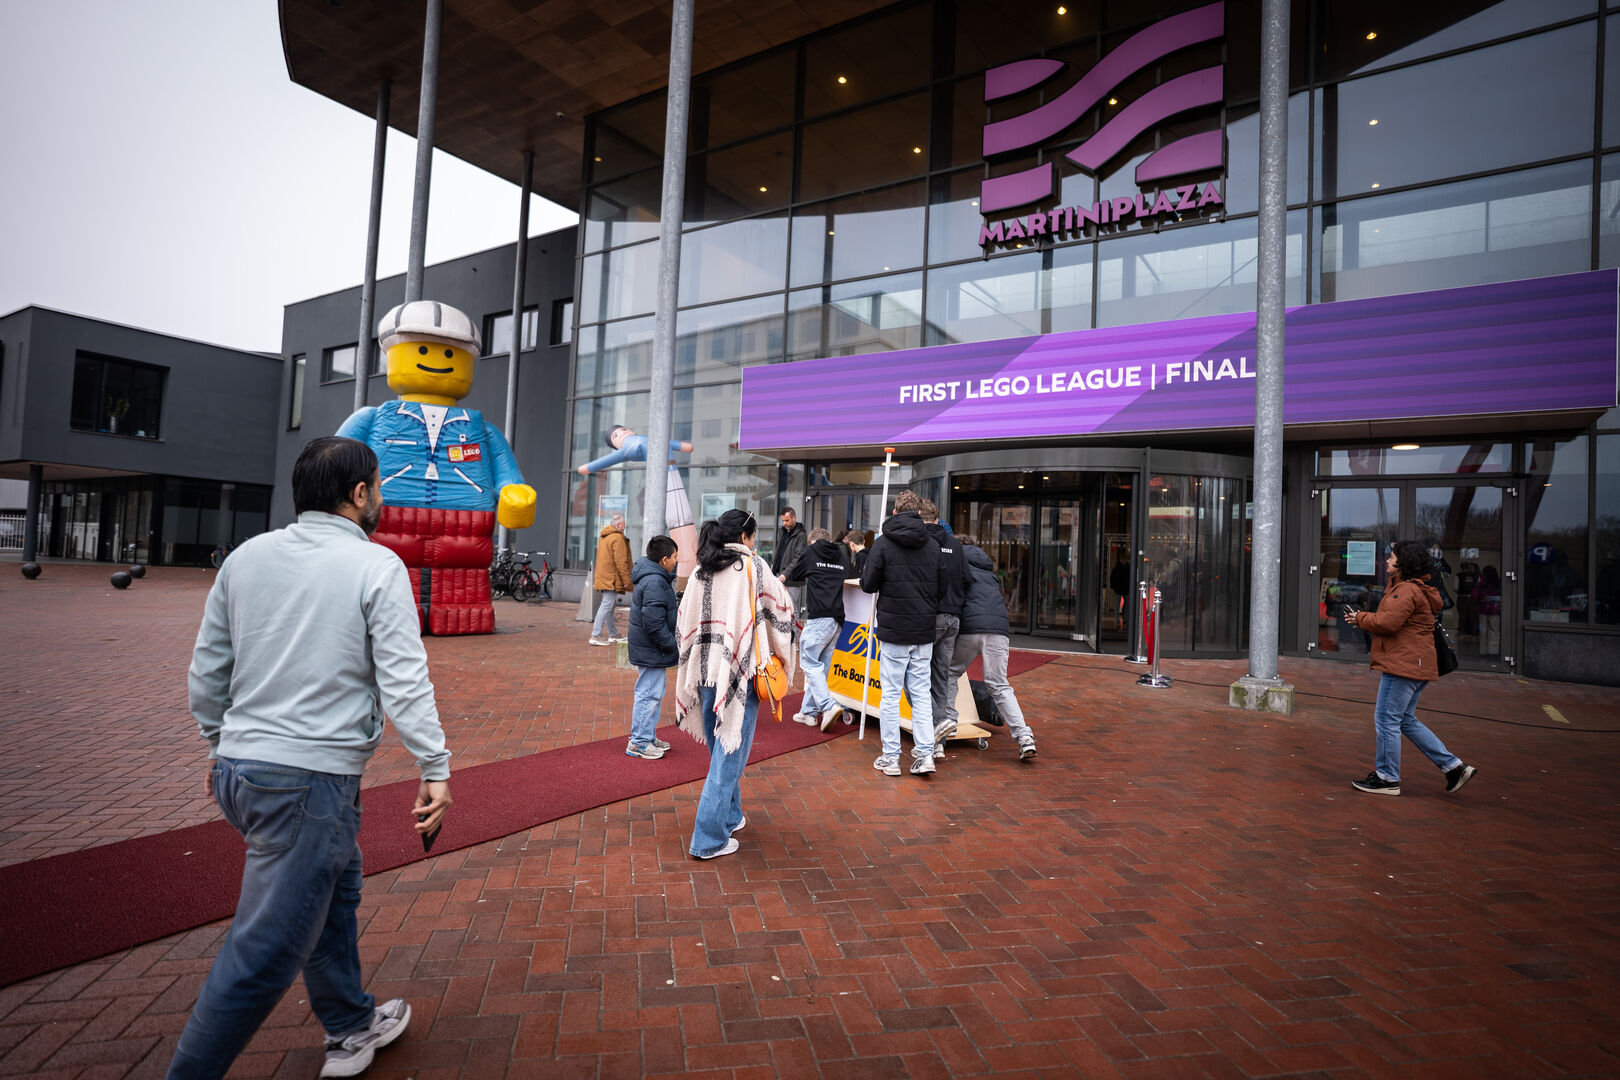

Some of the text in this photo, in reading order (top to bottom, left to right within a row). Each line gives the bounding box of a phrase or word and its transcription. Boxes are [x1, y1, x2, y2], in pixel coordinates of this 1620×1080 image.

[978, 181, 1223, 246] MARTINIPLAZA
[899, 381, 961, 404] FIRST
[966, 375, 1030, 399] LEGO
[1036, 366, 1142, 394] LEAGUE
[1166, 356, 1256, 384] FINAL
[463, 448, 480, 456] LEGO
[833, 664, 882, 690] The Banna
